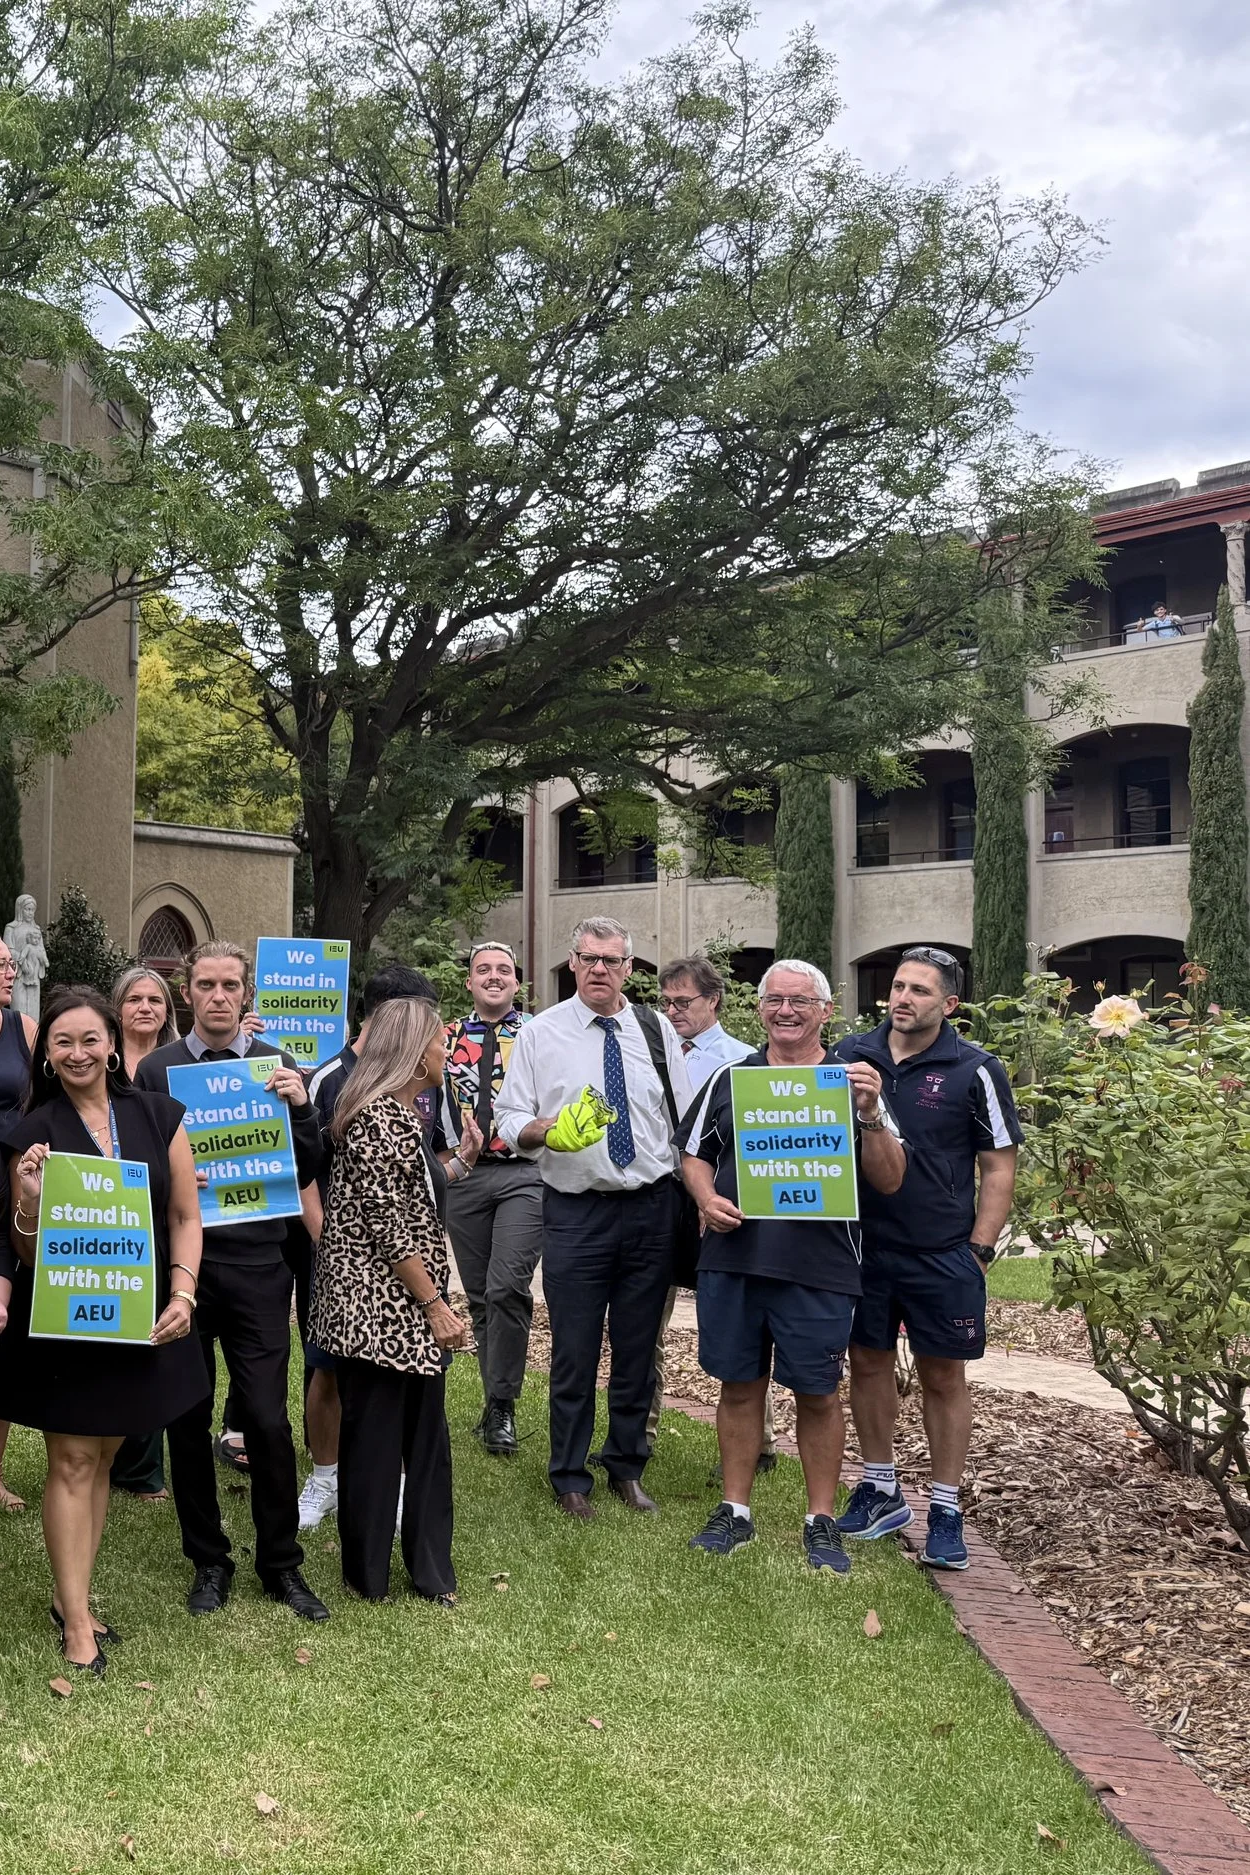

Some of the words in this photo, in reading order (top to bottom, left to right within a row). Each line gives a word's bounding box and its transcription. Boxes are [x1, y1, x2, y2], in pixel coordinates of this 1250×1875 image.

[286, 950, 315, 964] We
[329, 945, 344, 953] IEU
[263, 972, 315, 987] stand
[318, 973, 335, 988] in
[261, 995, 338, 1012] solidarity
[263, 1016, 302, 1032] with
[305, 1019, 335, 1033] the
[284, 1042, 313, 1054] AEU
[257, 1063, 274, 1073] IEU
[823, 1071, 842, 1080] IEU
[206, 1076, 243, 1095] We
[769, 1080, 807, 1097] We
[182, 1101, 248, 1126] stand
[251, 1099, 274, 1119] in
[743, 1106, 810, 1124] stand
[814, 1105, 836, 1123] in
[745, 1132, 843, 1152] solidarity
[127, 1168, 142, 1178] IEU
[244, 1158, 283, 1175] the
[748, 1159, 799, 1178] with
[803, 1160, 843, 1178] the
[81, 1172, 115, 1193] We
[223, 1187, 260, 1208] AEU
[778, 1189, 817, 1205] AEU
[50, 1202, 117, 1225] stand
[121, 1205, 140, 1227] in
[48, 1237, 145, 1261] solidarity
[48, 1266, 100, 1289] with
[105, 1271, 144, 1292] the
[73, 1304, 115, 1321] AEU
